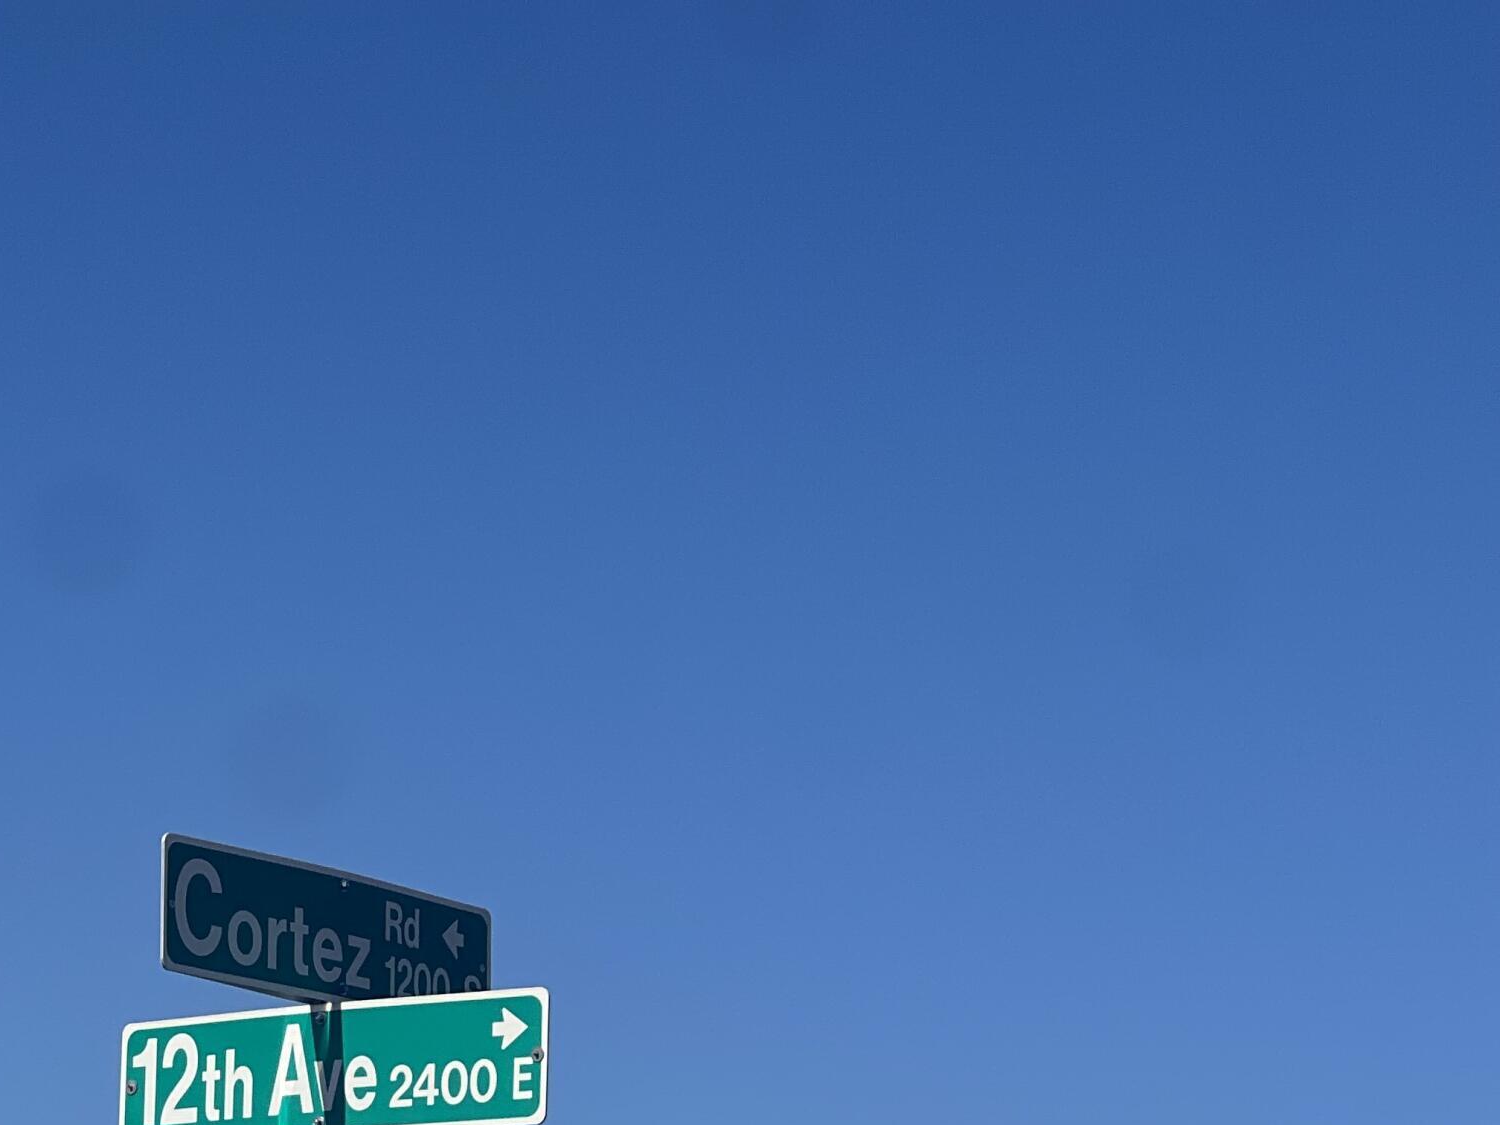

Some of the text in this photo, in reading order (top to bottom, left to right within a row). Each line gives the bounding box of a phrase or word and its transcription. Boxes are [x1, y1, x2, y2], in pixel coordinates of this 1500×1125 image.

[174, 858, 420, 990] Cortez Rd
[384, 955, 451, 997] 1200
[267, 1023, 377, 1117] Ave
[388, 1059, 497, 1108] 2400
[513, 1056, 533, 1101] E
